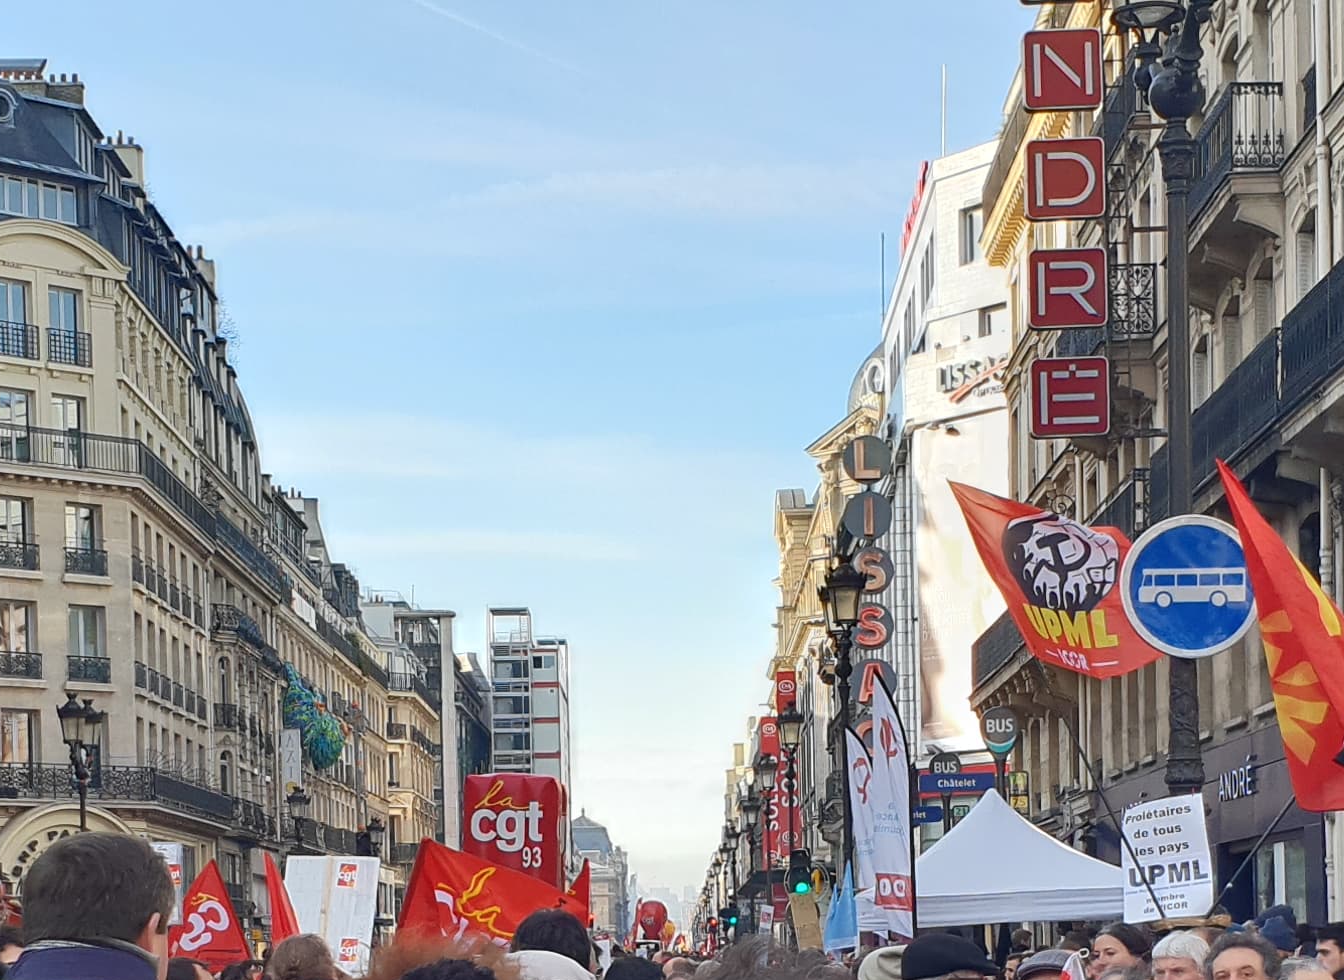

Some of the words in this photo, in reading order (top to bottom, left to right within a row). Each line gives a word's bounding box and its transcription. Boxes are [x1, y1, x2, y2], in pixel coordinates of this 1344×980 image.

[1022, 603, 1119, 649] UPML
[986, 718, 1014, 733] BUS
[933, 761, 958, 773] BUS
[937, 778, 976, 788] Châtelet
[1218, 755, 1254, 802] ANDRÉ
[474, 780, 544, 810] la
[470, 801, 543, 852] cgt
[1133, 829, 1149, 840] de
[1153, 824, 1182, 836] tous
[1158, 841, 1190, 855] pays
[522, 847, 542, 868] 93
[1128, 859, 1209, 888] UPML
[1159, 901, 1189, 912] 'ICOR
